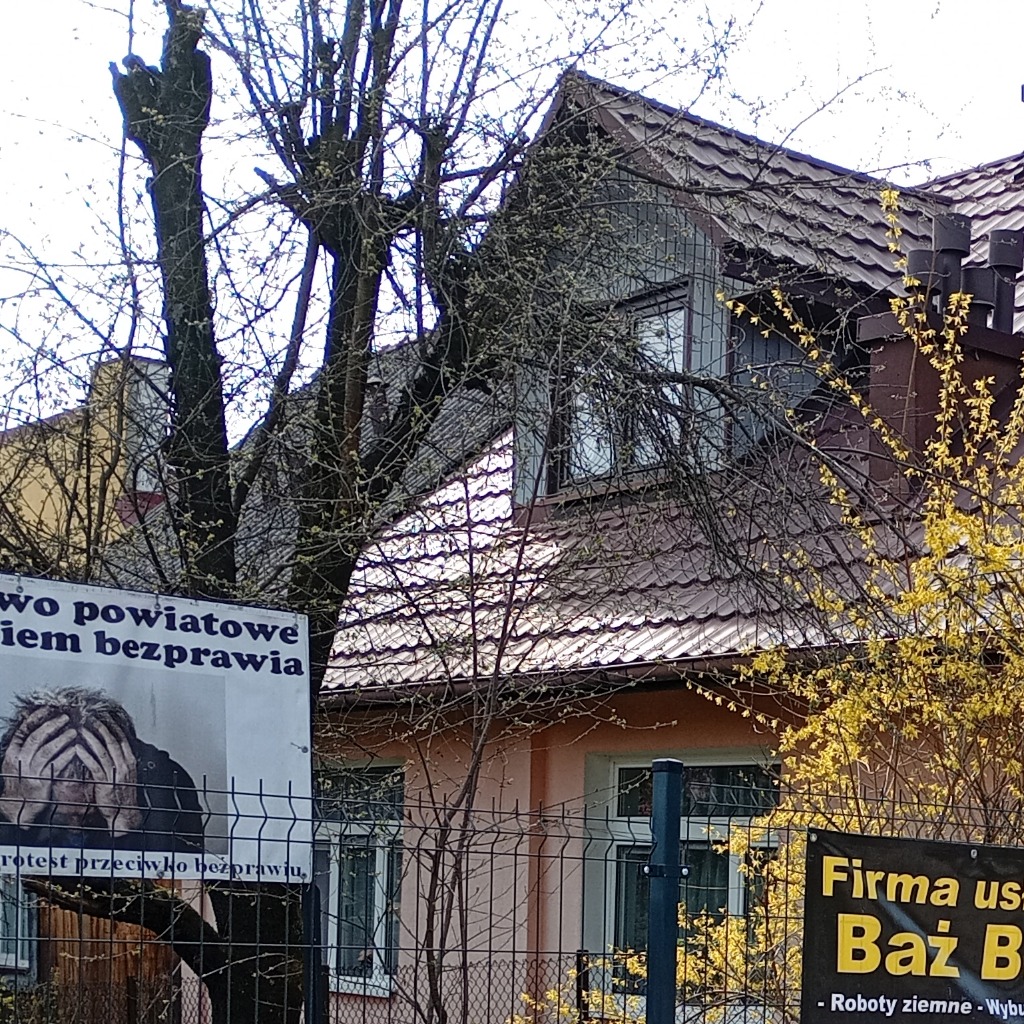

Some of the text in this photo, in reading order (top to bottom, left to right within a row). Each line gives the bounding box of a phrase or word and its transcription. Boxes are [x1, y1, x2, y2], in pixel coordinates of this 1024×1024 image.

[73, 601, 299, 645] powiatowe
[93, 630, 305, 676] bezprawia
[75, 855, 188, 876] przeciwko
[822, 855, 960, 907] Firma
[837, 913, 960, 978] Baż
[831, 993, 898, 1017] Roboty
[901, 995, 973, 1014] ziemne
